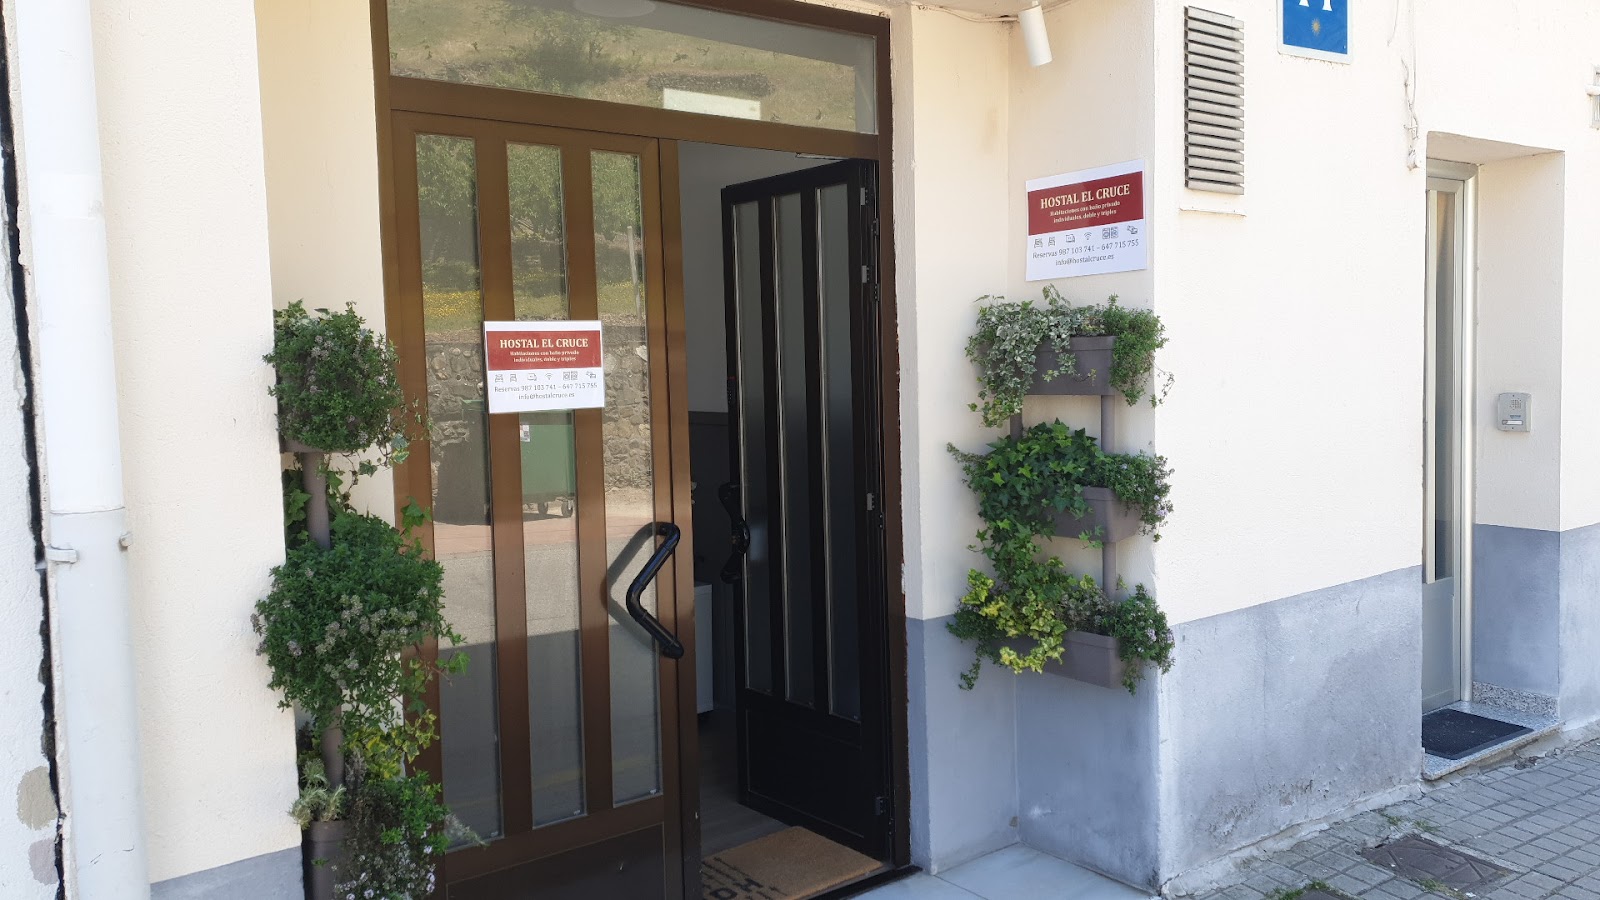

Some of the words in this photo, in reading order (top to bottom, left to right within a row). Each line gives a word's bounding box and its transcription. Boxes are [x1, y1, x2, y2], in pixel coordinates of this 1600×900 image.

[1040, 193, 1080, 209] HOSTAL
[1081, 190, 1094, 202] EL
[1096, 184, 1130, 200] CRUCE
[1050, 208, 1080, 216] Habitaciones
[1102, 200, 1120, 209] privado
[1128, 239, 1139, 247] 755
[1056, 254, 1114, 266] info@hostalcruce.es
[500, 339, 540, 348] HOSTAL
[542, 339, 554, 348] EL
[556, 338, 588, 348] CRUCE
